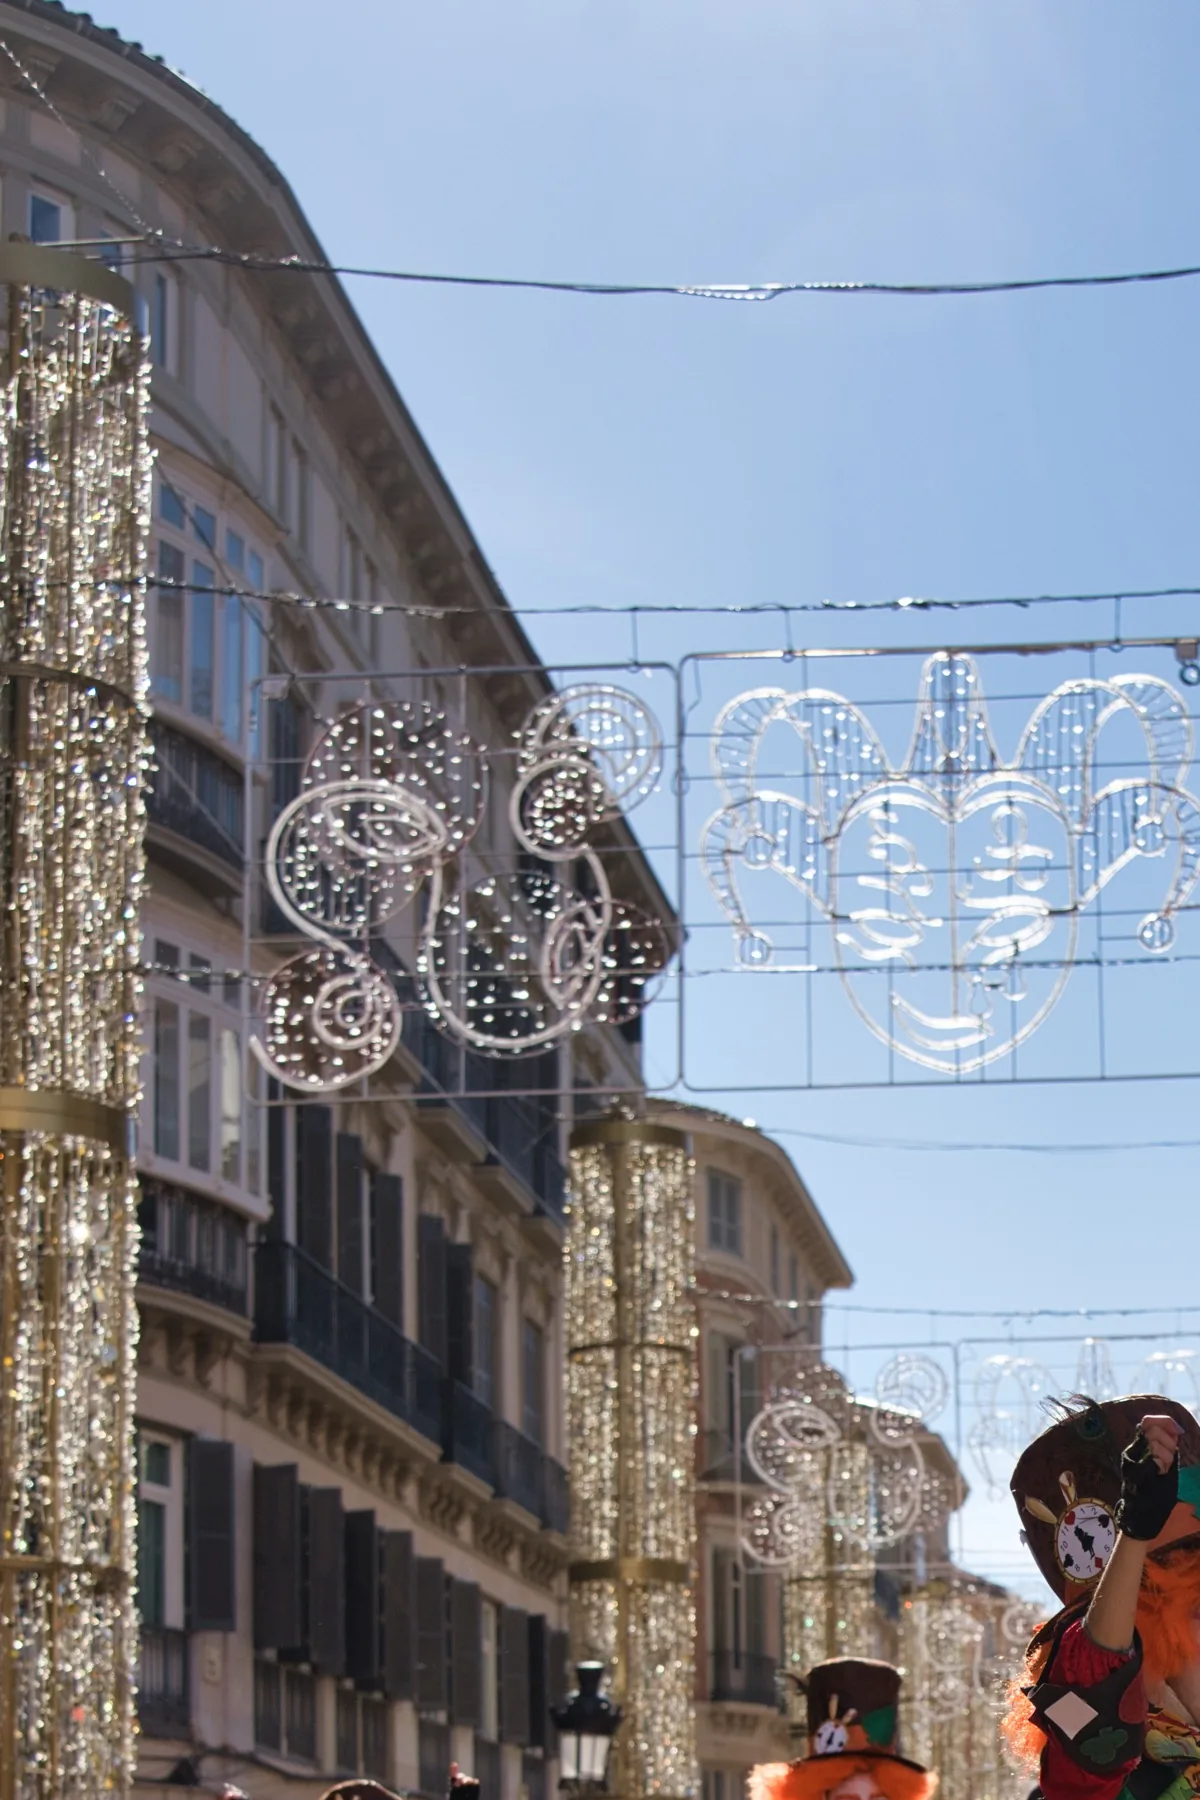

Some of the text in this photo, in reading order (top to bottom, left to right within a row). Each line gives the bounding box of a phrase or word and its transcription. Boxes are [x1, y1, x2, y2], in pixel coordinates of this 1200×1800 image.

[1091, 1507, 1098, 1516] 2
[1061, 1526, 1070, 1537] 11
[1060, 1541, 1069, 1552] 10
[1104, 1543, 1111, 1553] 5
[1074, 1563, 1080, 1572] 8
